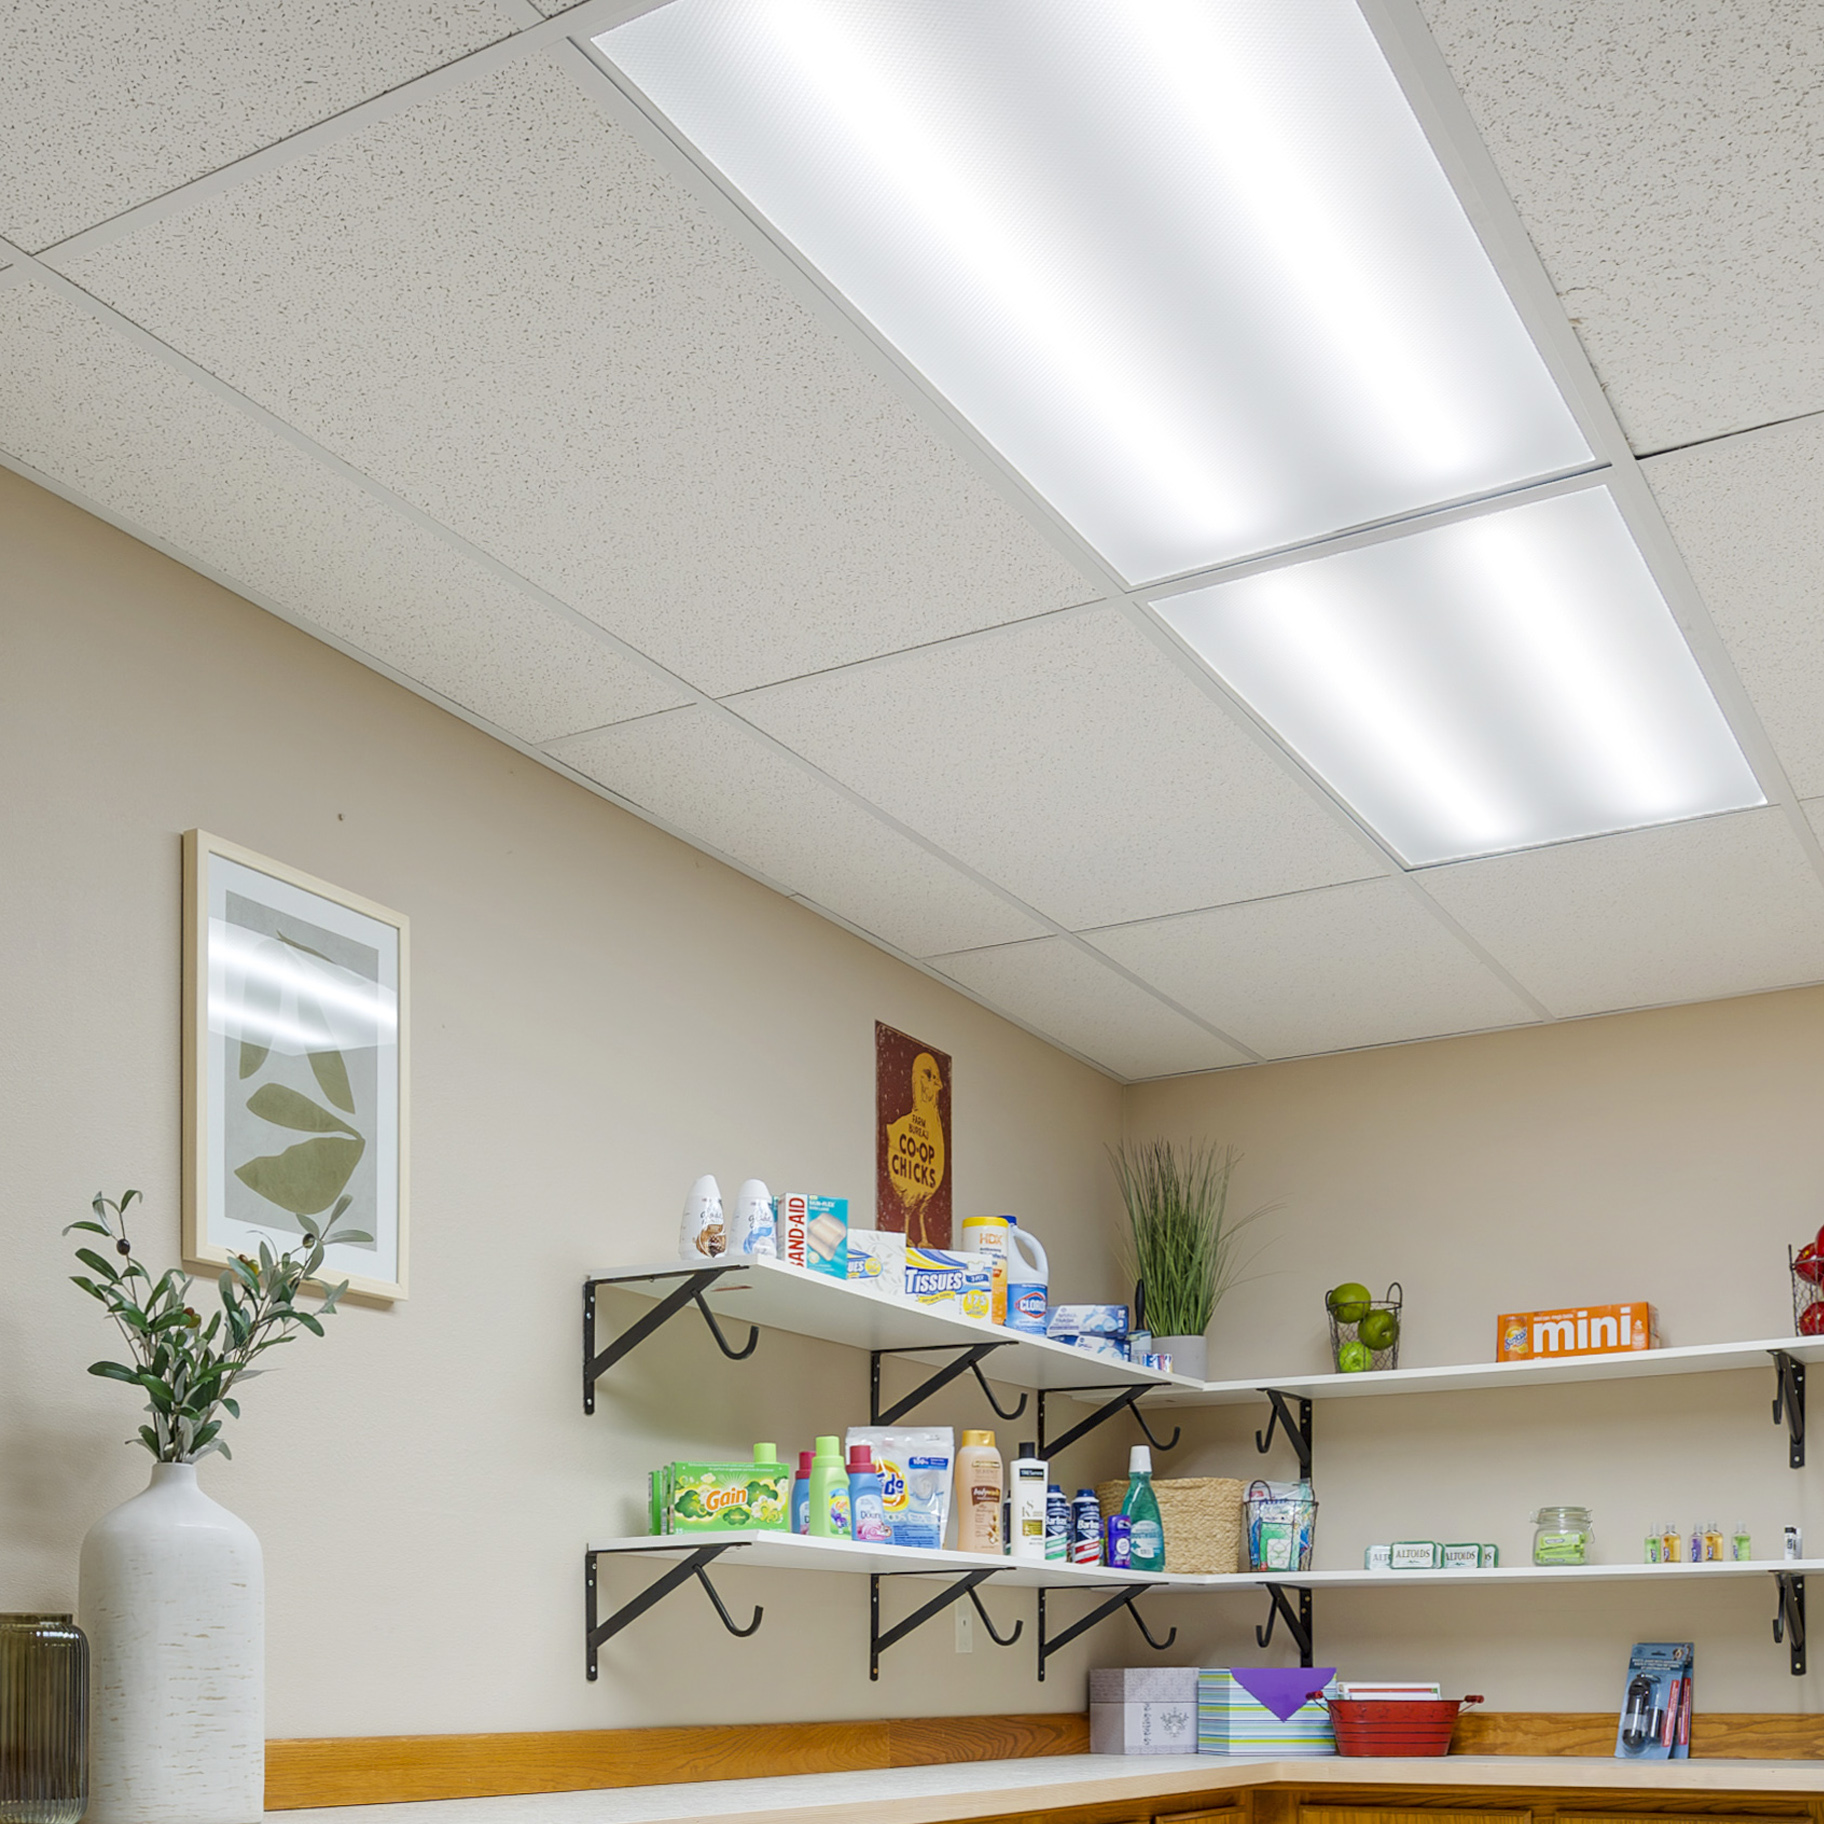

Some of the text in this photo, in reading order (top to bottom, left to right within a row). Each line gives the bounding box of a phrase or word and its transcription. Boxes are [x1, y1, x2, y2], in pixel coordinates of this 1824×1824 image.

[891, 1154, 936, 1188] CHICKS
[979, 1233, 1003, 1245] HDX
[906, 1269, 963, 1294] TISSUES
[1533, 1307, 1631, 1353] mini
[705, 1488, 748, 1512] Gain
[1396, 1550, 1431, 1558] ALTOIDS
